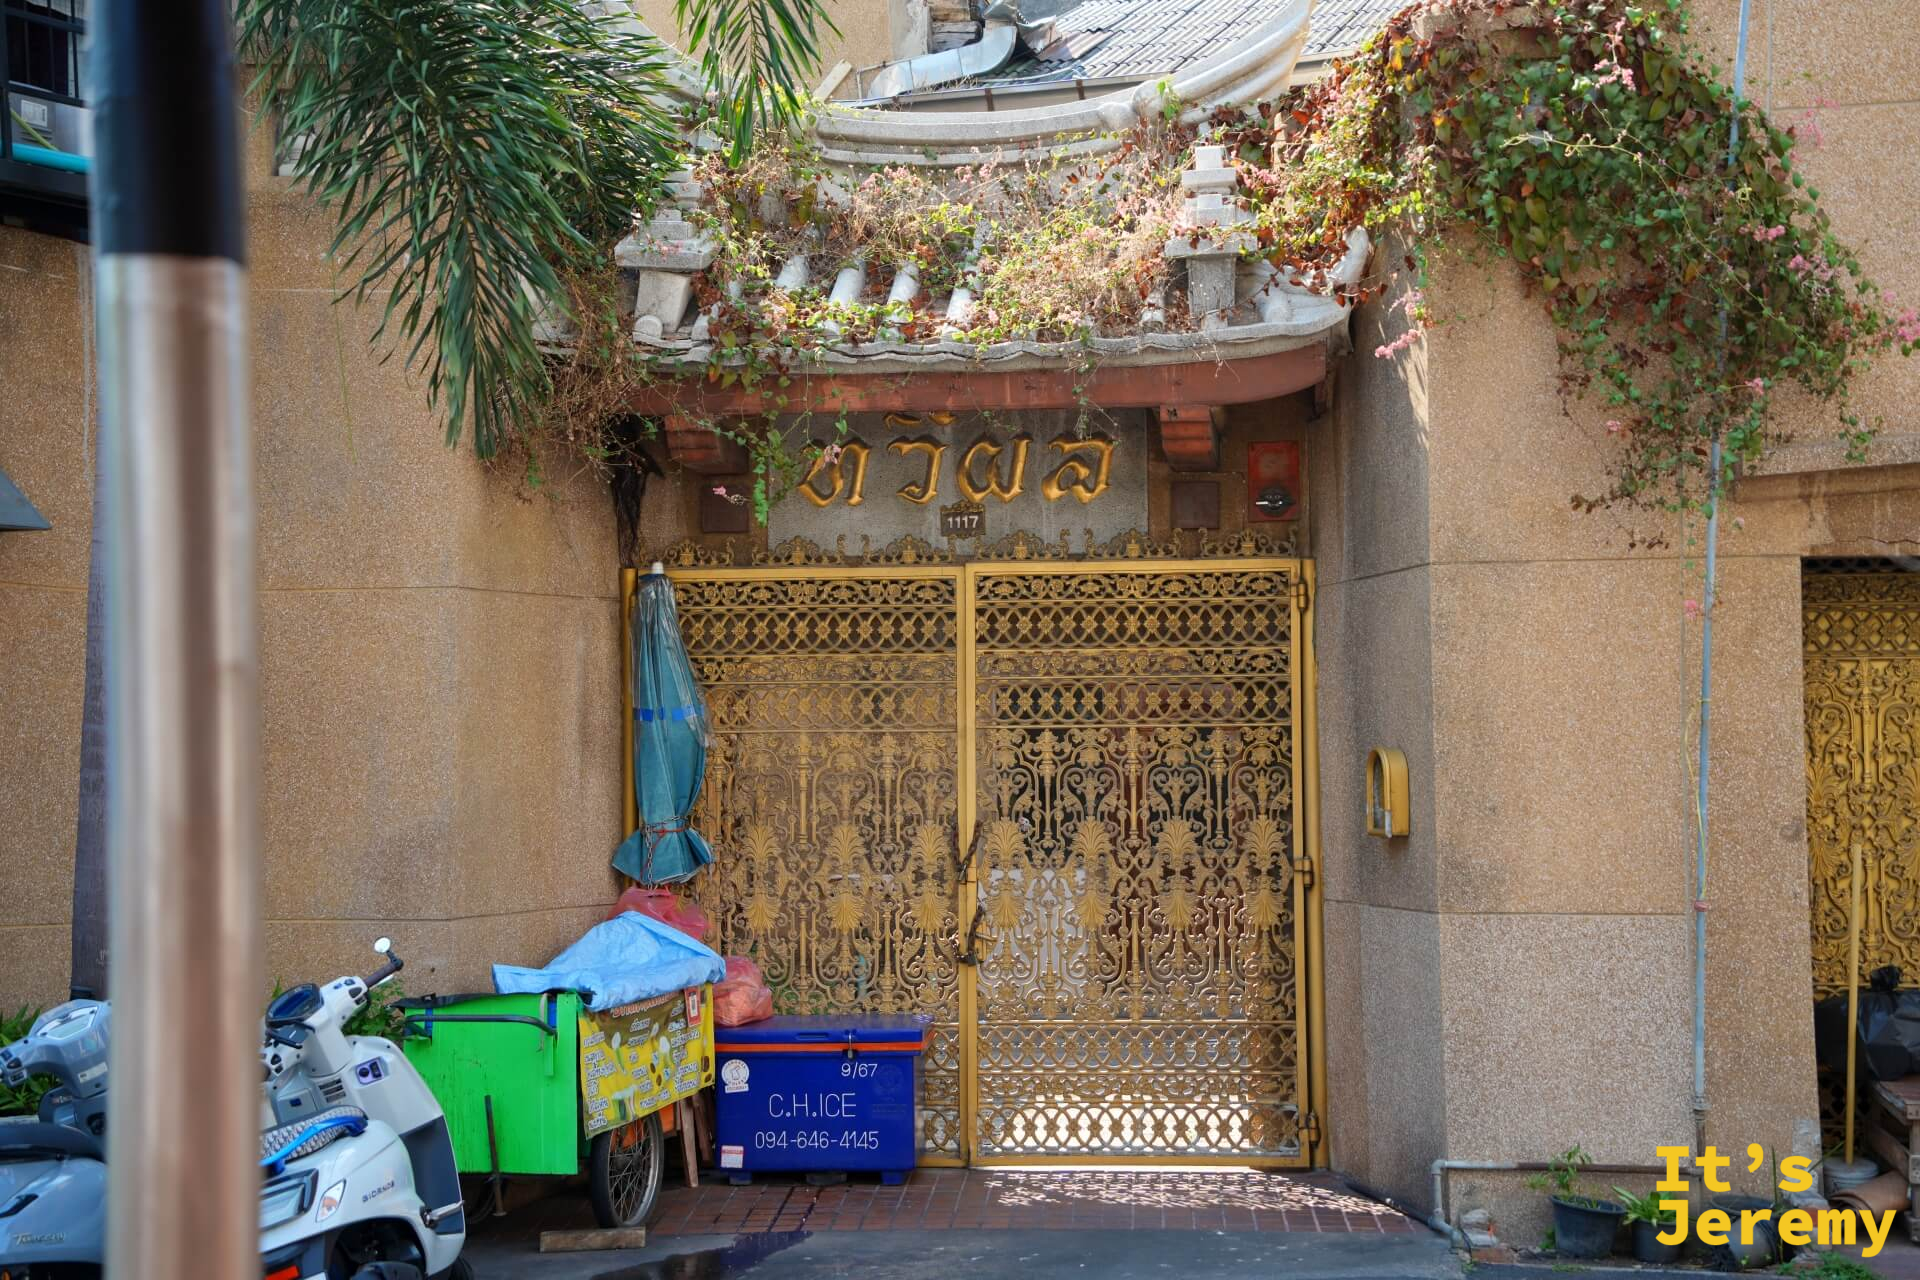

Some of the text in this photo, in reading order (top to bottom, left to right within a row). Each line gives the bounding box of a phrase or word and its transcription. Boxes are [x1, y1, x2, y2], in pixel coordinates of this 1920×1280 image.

[946, 515, 980, 529] 1117
[840, 1062, 879, 1079] 9/67
[768, 1093, 857, 1118] C.H.ICE
[754, 1131, 880, 1150] 094-646-4145
